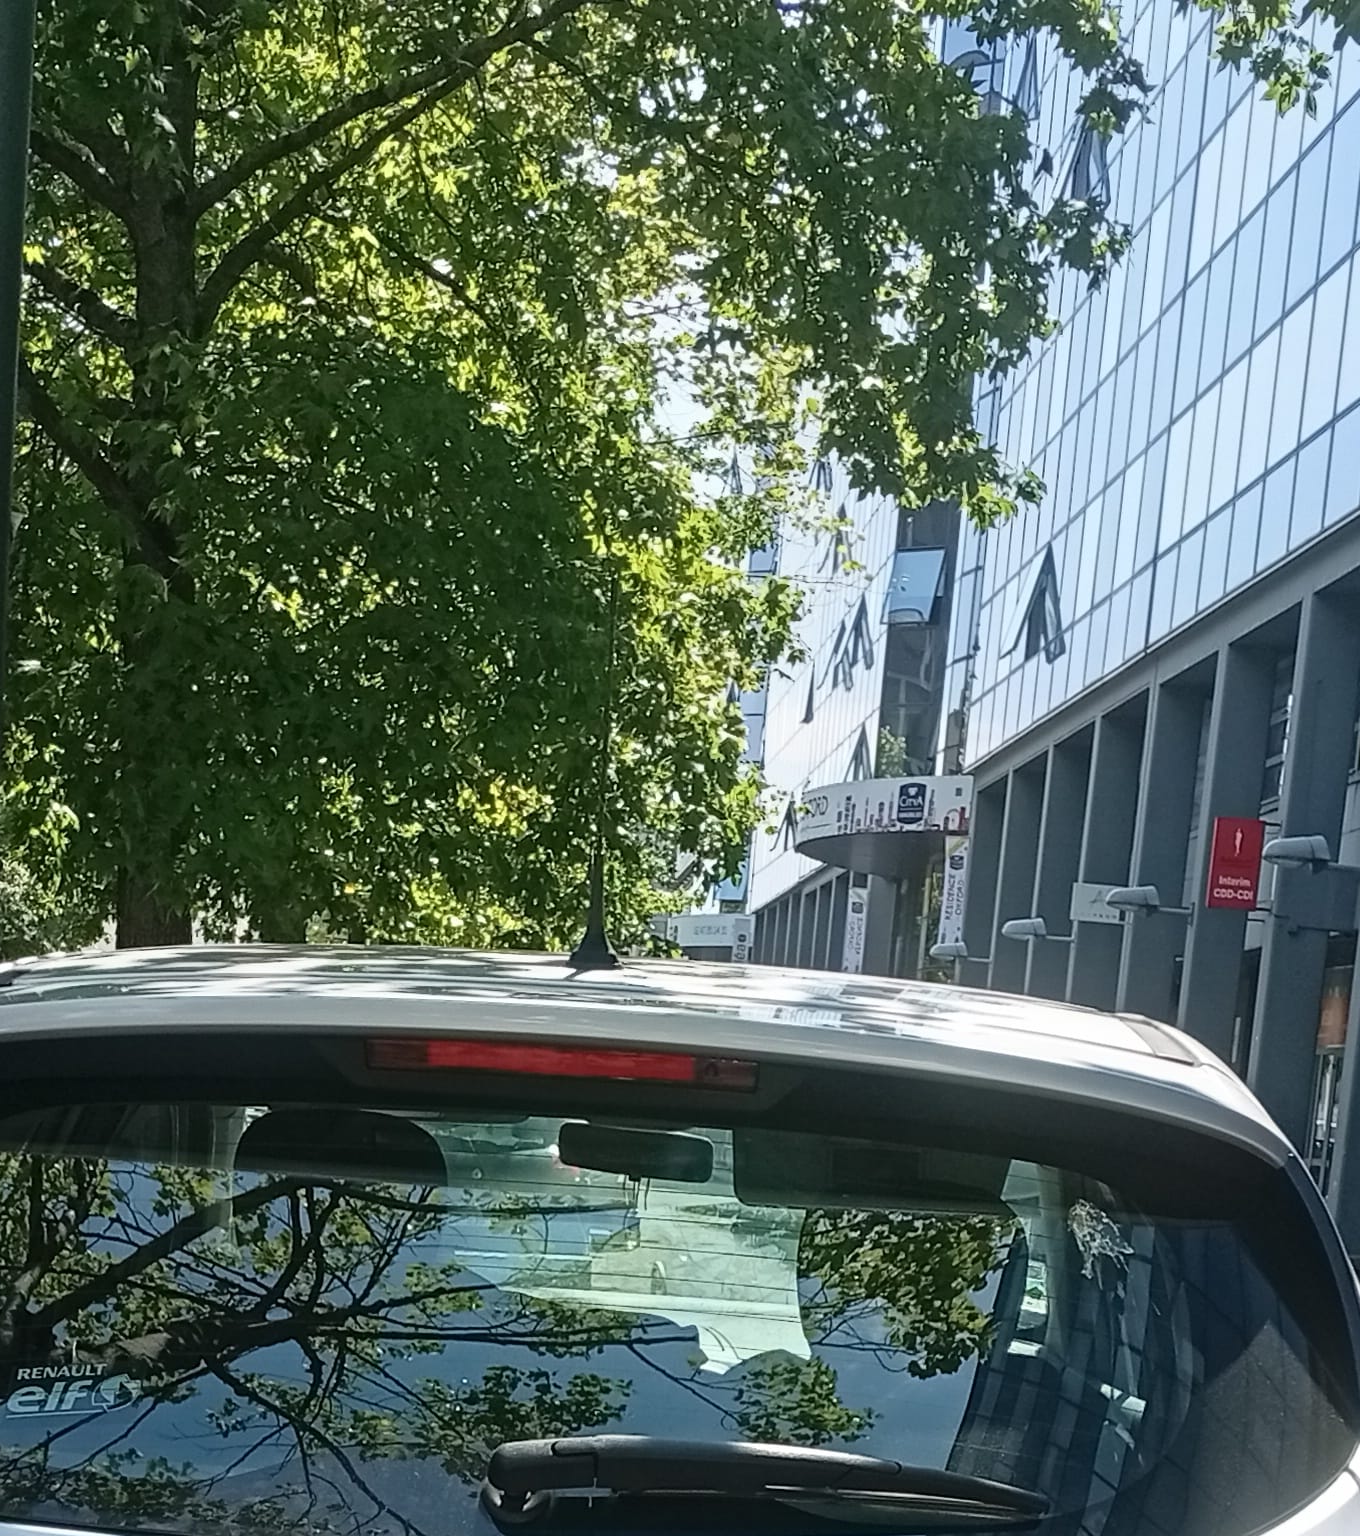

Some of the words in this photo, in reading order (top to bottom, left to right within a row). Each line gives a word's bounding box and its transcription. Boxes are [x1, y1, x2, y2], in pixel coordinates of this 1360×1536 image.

[1213, 888, 1254, 900] CDD-CDI
[17, 1363, 108, 1380] RENAULT
[6, 1379, 94, 1413] elf
